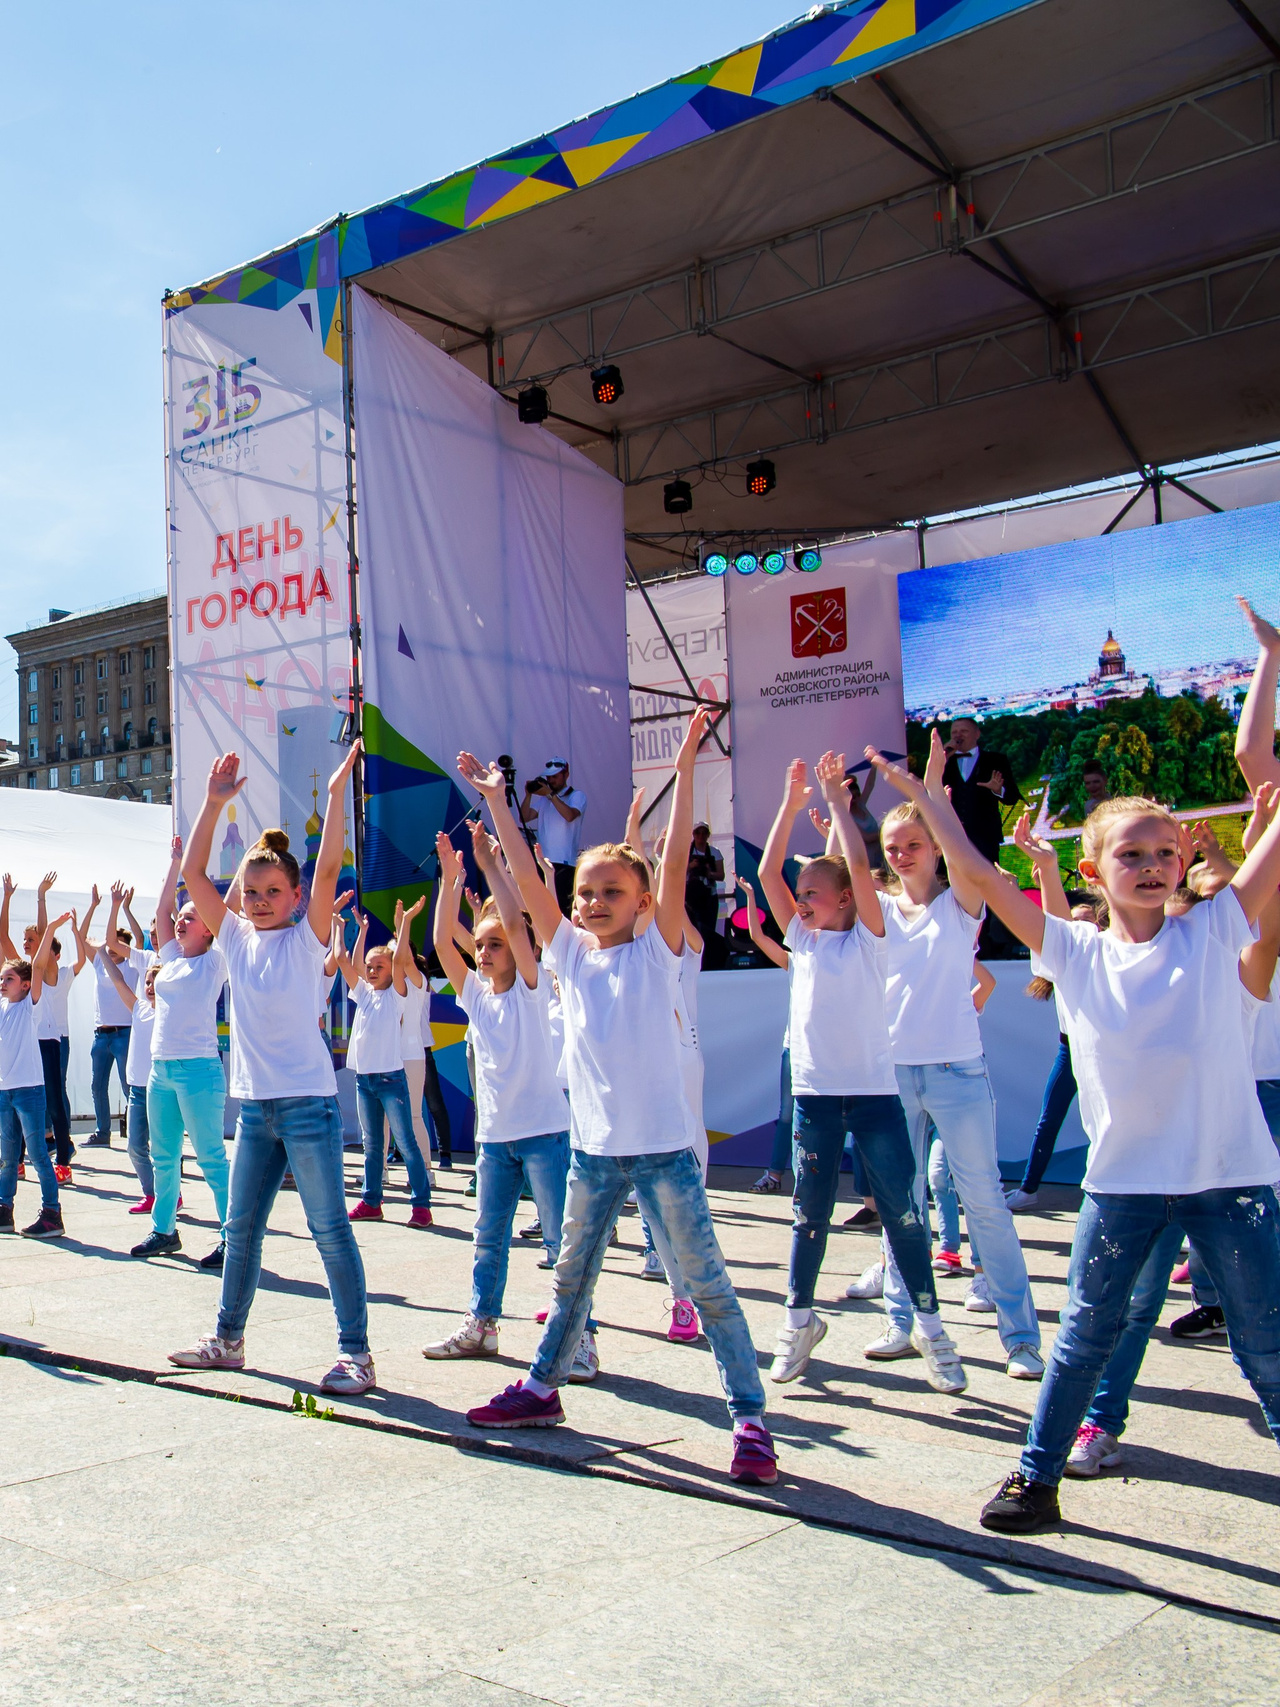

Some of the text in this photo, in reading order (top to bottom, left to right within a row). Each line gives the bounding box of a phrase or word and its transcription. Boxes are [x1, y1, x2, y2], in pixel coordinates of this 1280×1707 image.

[182, 357, 261, 440] 315
[180, 425, 259, 463] САНКТ-
[183, 444, 259, 478] ПЕТЕРБУРГ
[210, 515, 305, 579] ДЕНЬ
[186, 565, 335, 635] ГОРОДА
[760, 671, 891, 697] МОСКОВСКОГО РАЙОНА
[775, 660, 873, 683] АДМИНИСТРАЦИЯ
[771, 686, 880, 708] САНКТ-ПЕТЕРБУРГА
